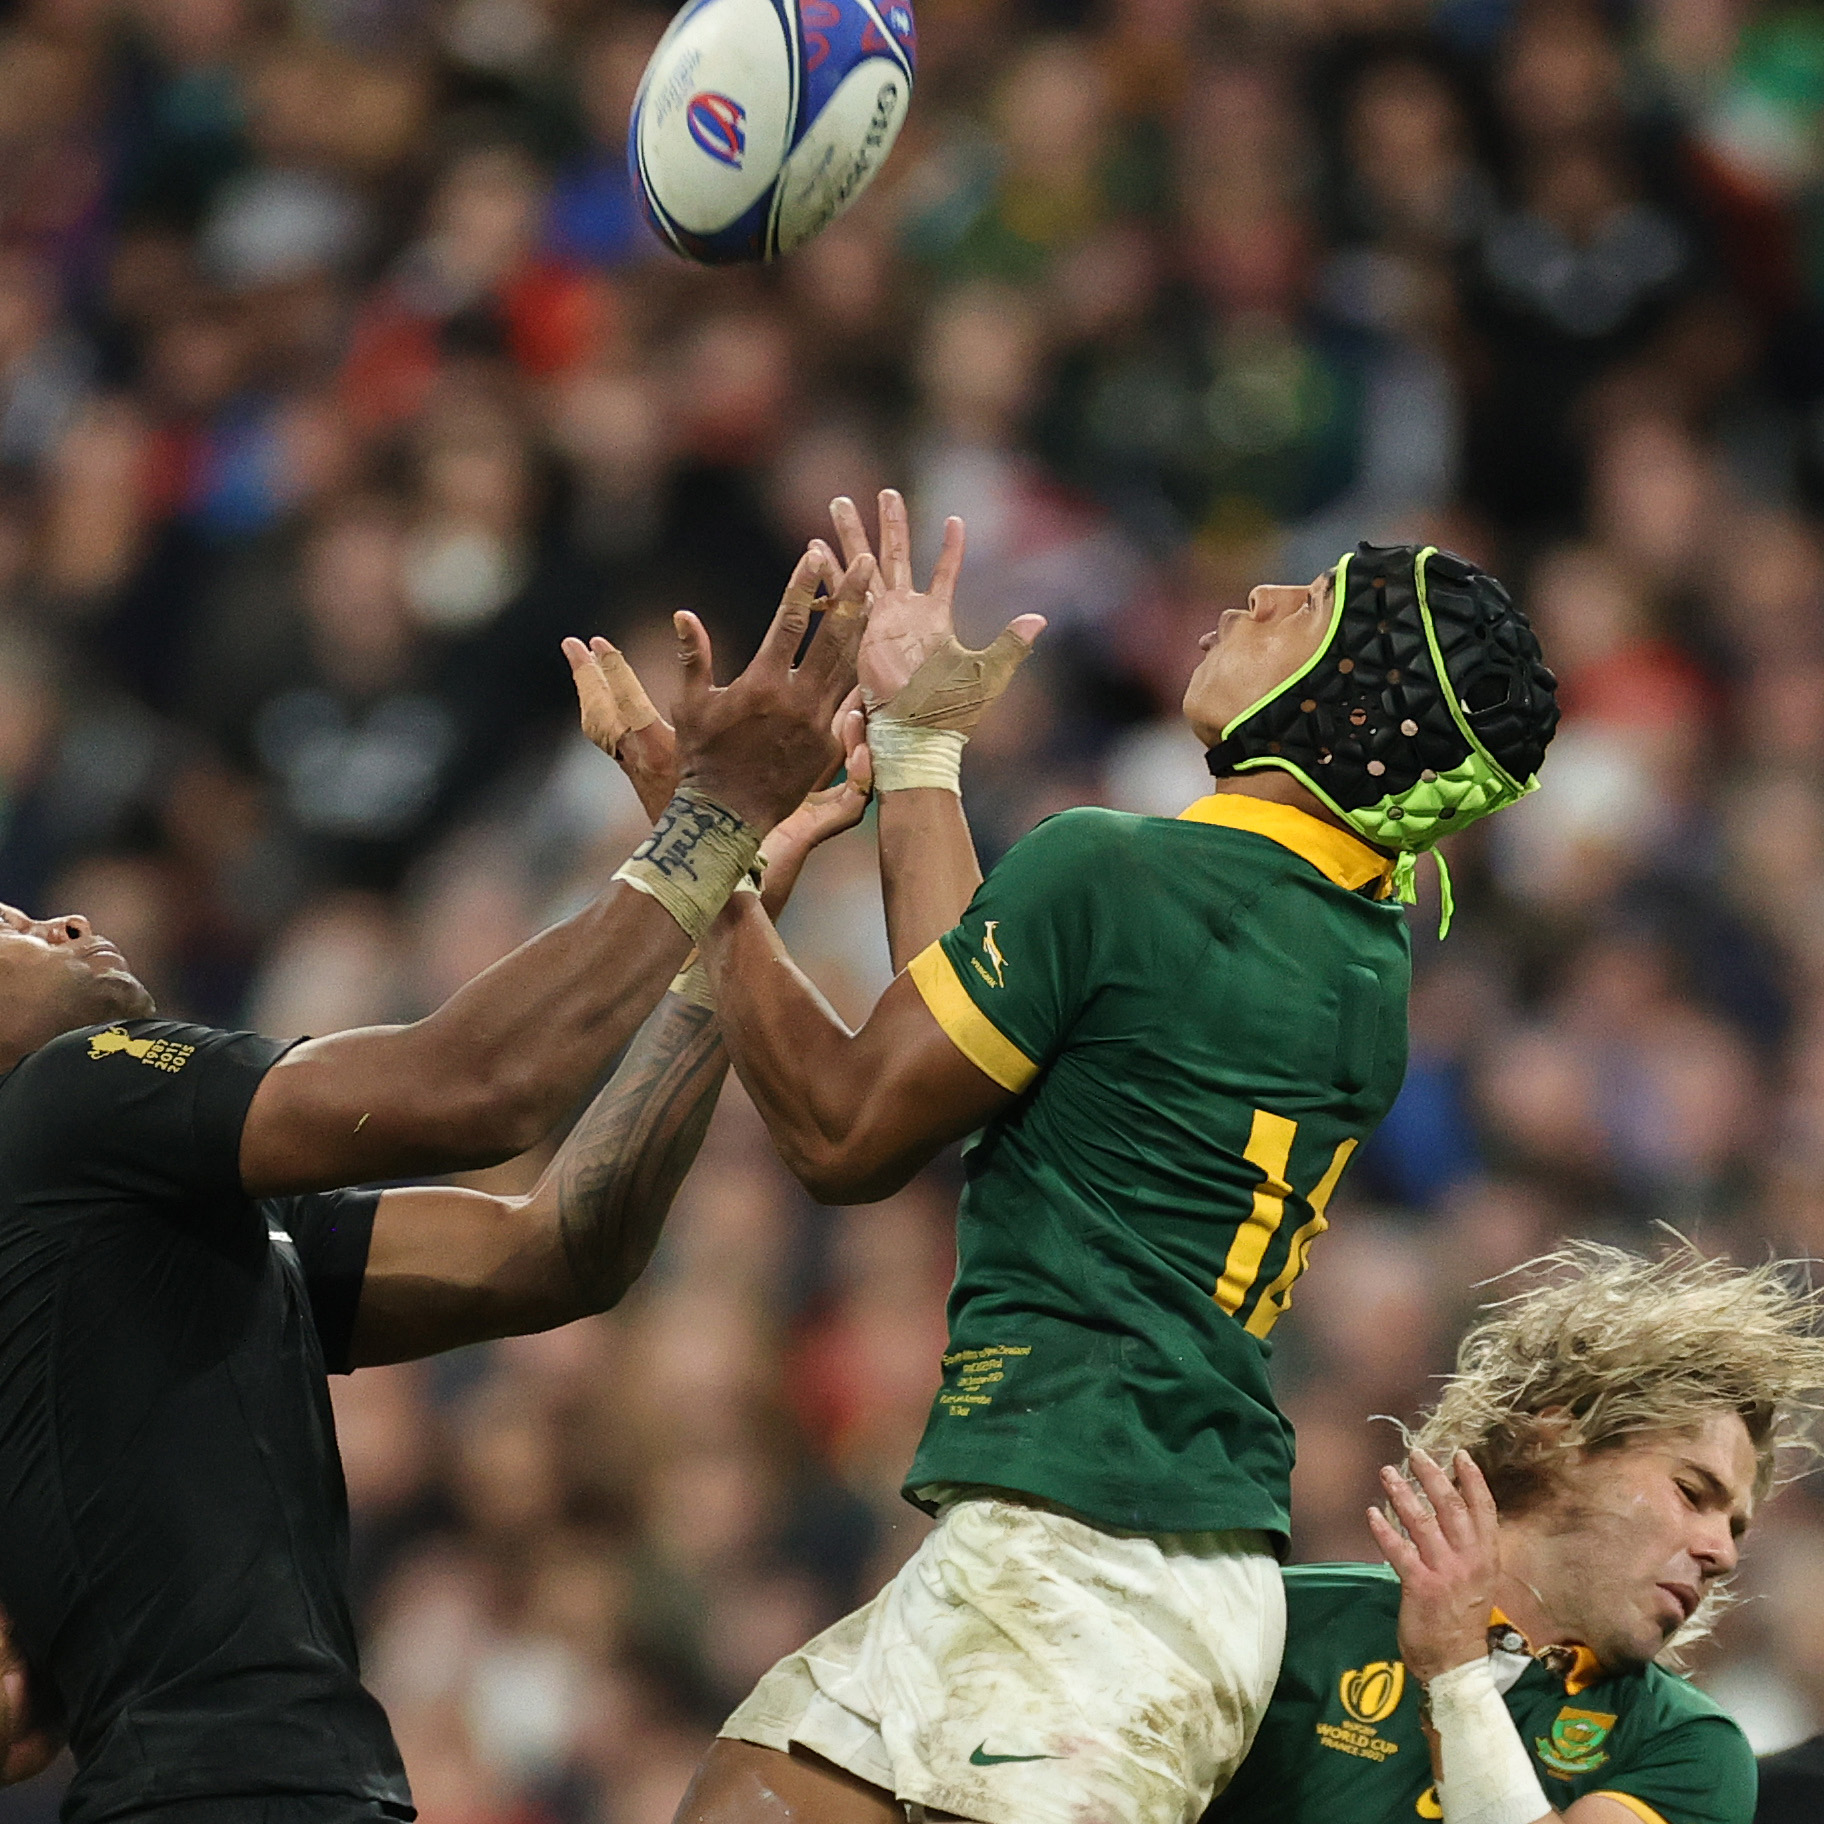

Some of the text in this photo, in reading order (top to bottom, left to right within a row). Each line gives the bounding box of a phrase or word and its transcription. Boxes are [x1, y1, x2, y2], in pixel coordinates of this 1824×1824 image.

[141, 1038, 169, 1065] 1987
[154, 1042, 182, 1071] 2011
[166, 1045, 195, 1073] 2015
[1316, 1722, 1399, 1755] WORLD CUP
